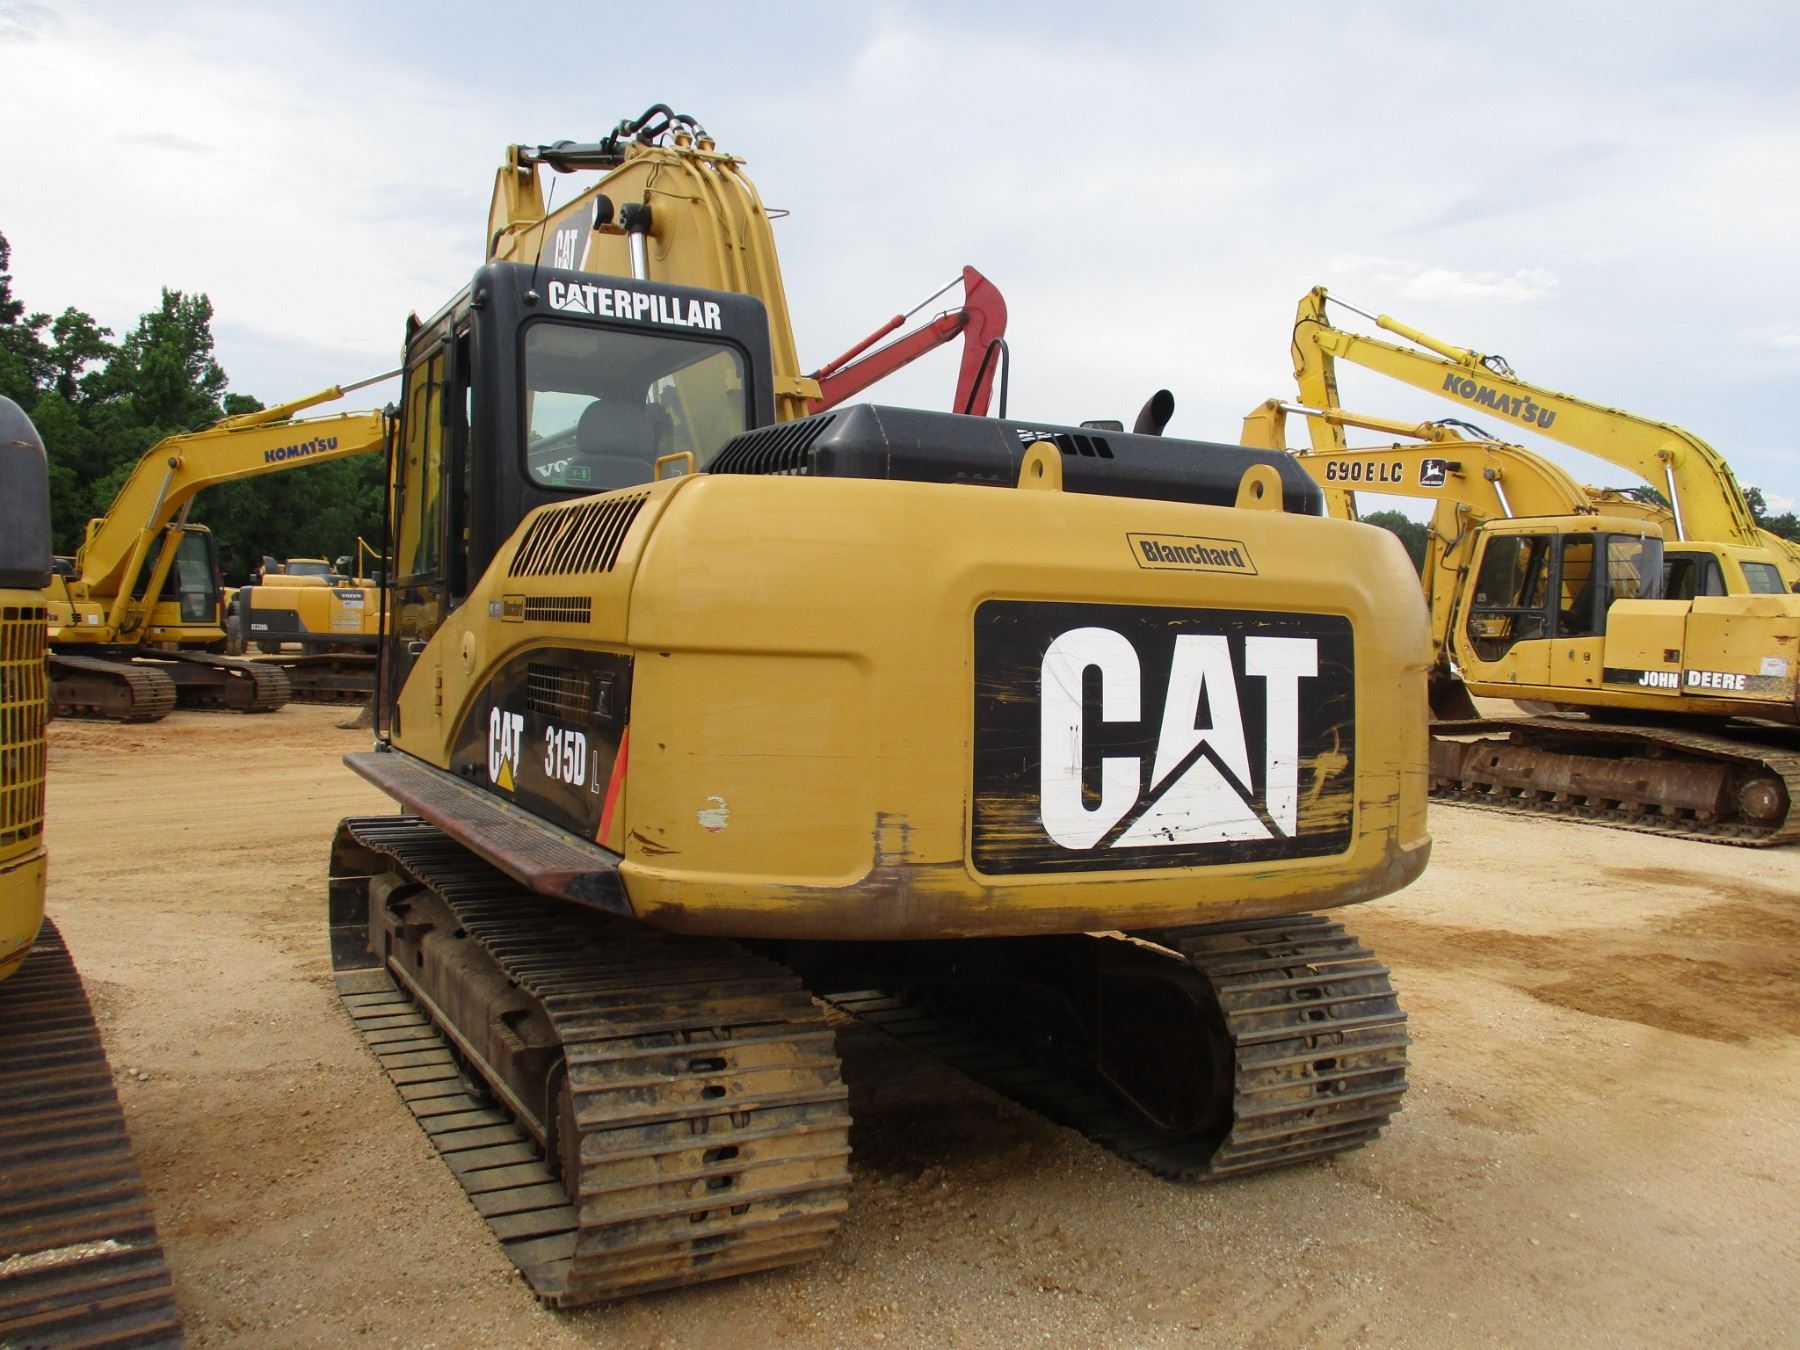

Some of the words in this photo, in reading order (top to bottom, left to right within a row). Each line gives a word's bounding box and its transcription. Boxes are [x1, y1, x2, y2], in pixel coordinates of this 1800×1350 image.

[554, 229, 578, 270] CAT
[548, 281, 722, 330] CATERPILLAR
[1442, 373, 1556, 428] KOMATSU
[264, 437, 337, 463] KOMATSU
[1140, 540, 1246, 567] Blanchard
[1639, 671, 1678, 688] JOHN
[1688, 670, 1745, 690] DEERE
[489, 706, 524, 792] CAT
[544, 725, 586, 786] 315D
[1041, 627, 1318, 849] CAT
